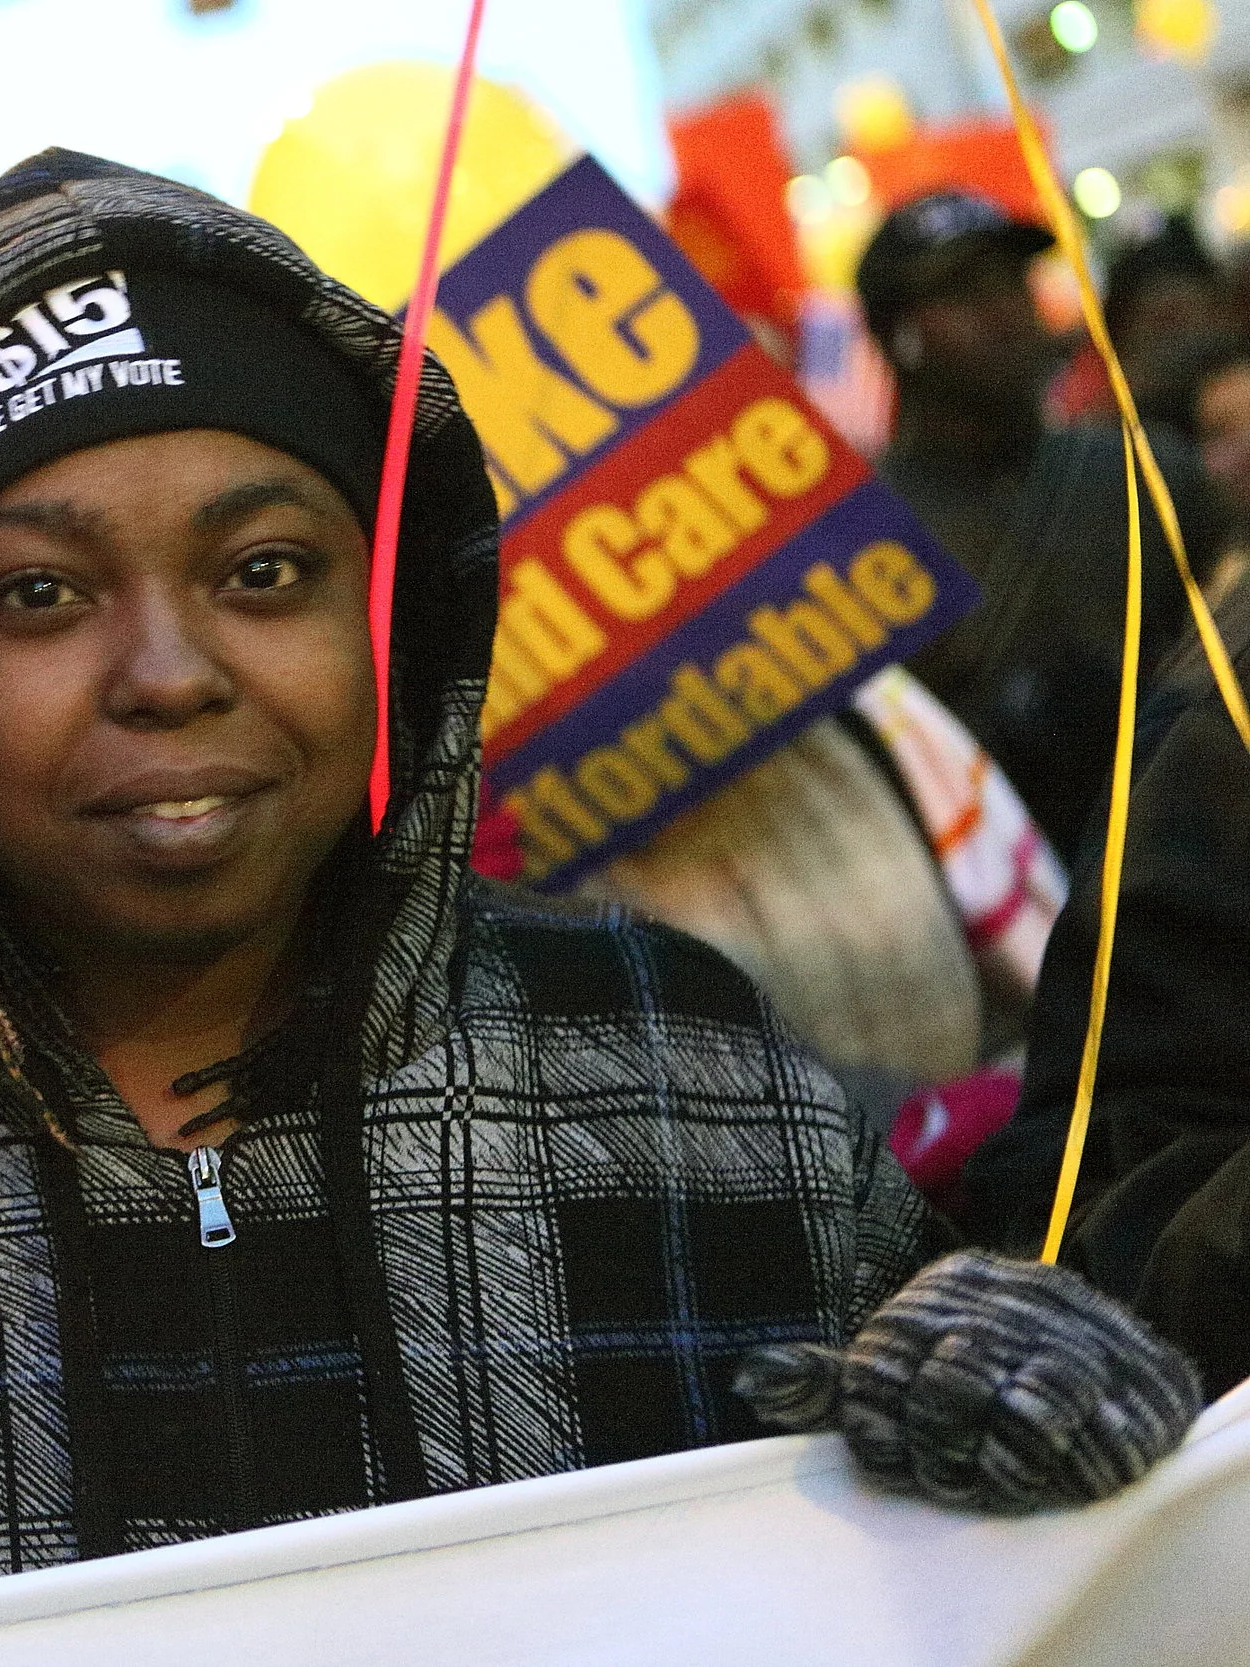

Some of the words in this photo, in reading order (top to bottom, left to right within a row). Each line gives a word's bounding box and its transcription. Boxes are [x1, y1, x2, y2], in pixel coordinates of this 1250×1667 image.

[7, 378, 57, 421] GET
[61, 363, 104, 400] MY
[109, 359, 185, 387] VOTE
[424, 228, 699, 518] ke
[562, 398, 831, 621] Care
[502, 541, 938, 875] ffordable
